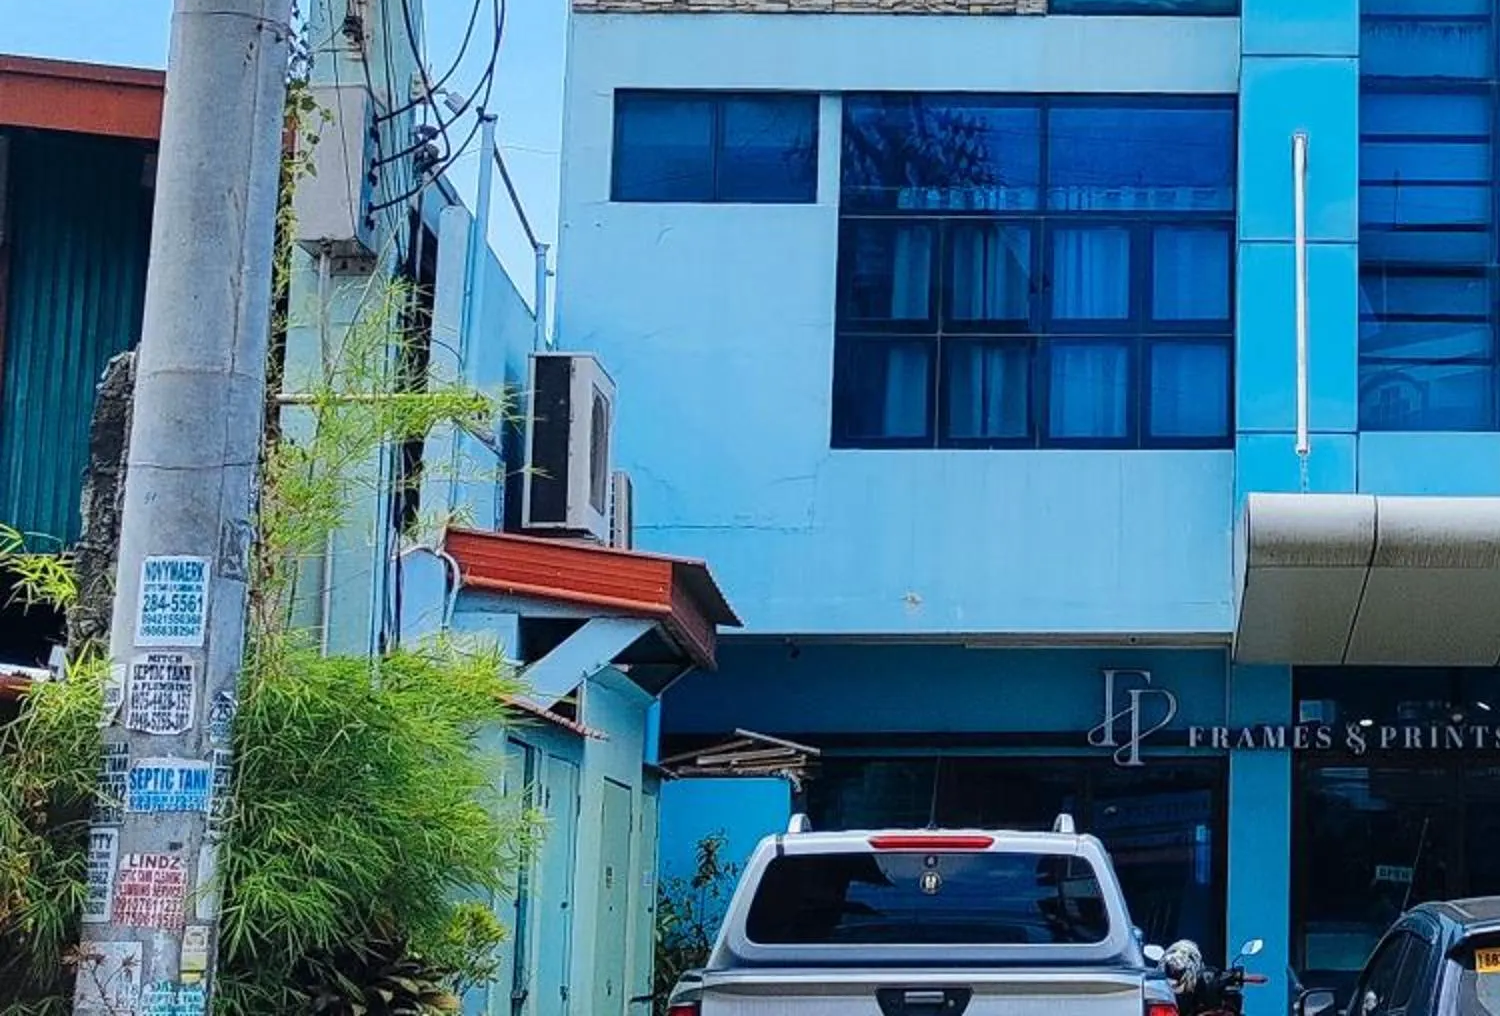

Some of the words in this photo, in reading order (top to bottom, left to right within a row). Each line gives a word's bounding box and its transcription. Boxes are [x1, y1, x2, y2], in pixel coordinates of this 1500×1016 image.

[143, 593, 203, 613] 284-5561
[1189, 725, 1333, 749] FRAMES
[1345, 722, 1367, 754] &
[129, 768, 175, 790] SEPTIC
[129, 854, 180, 870] LINDZ
